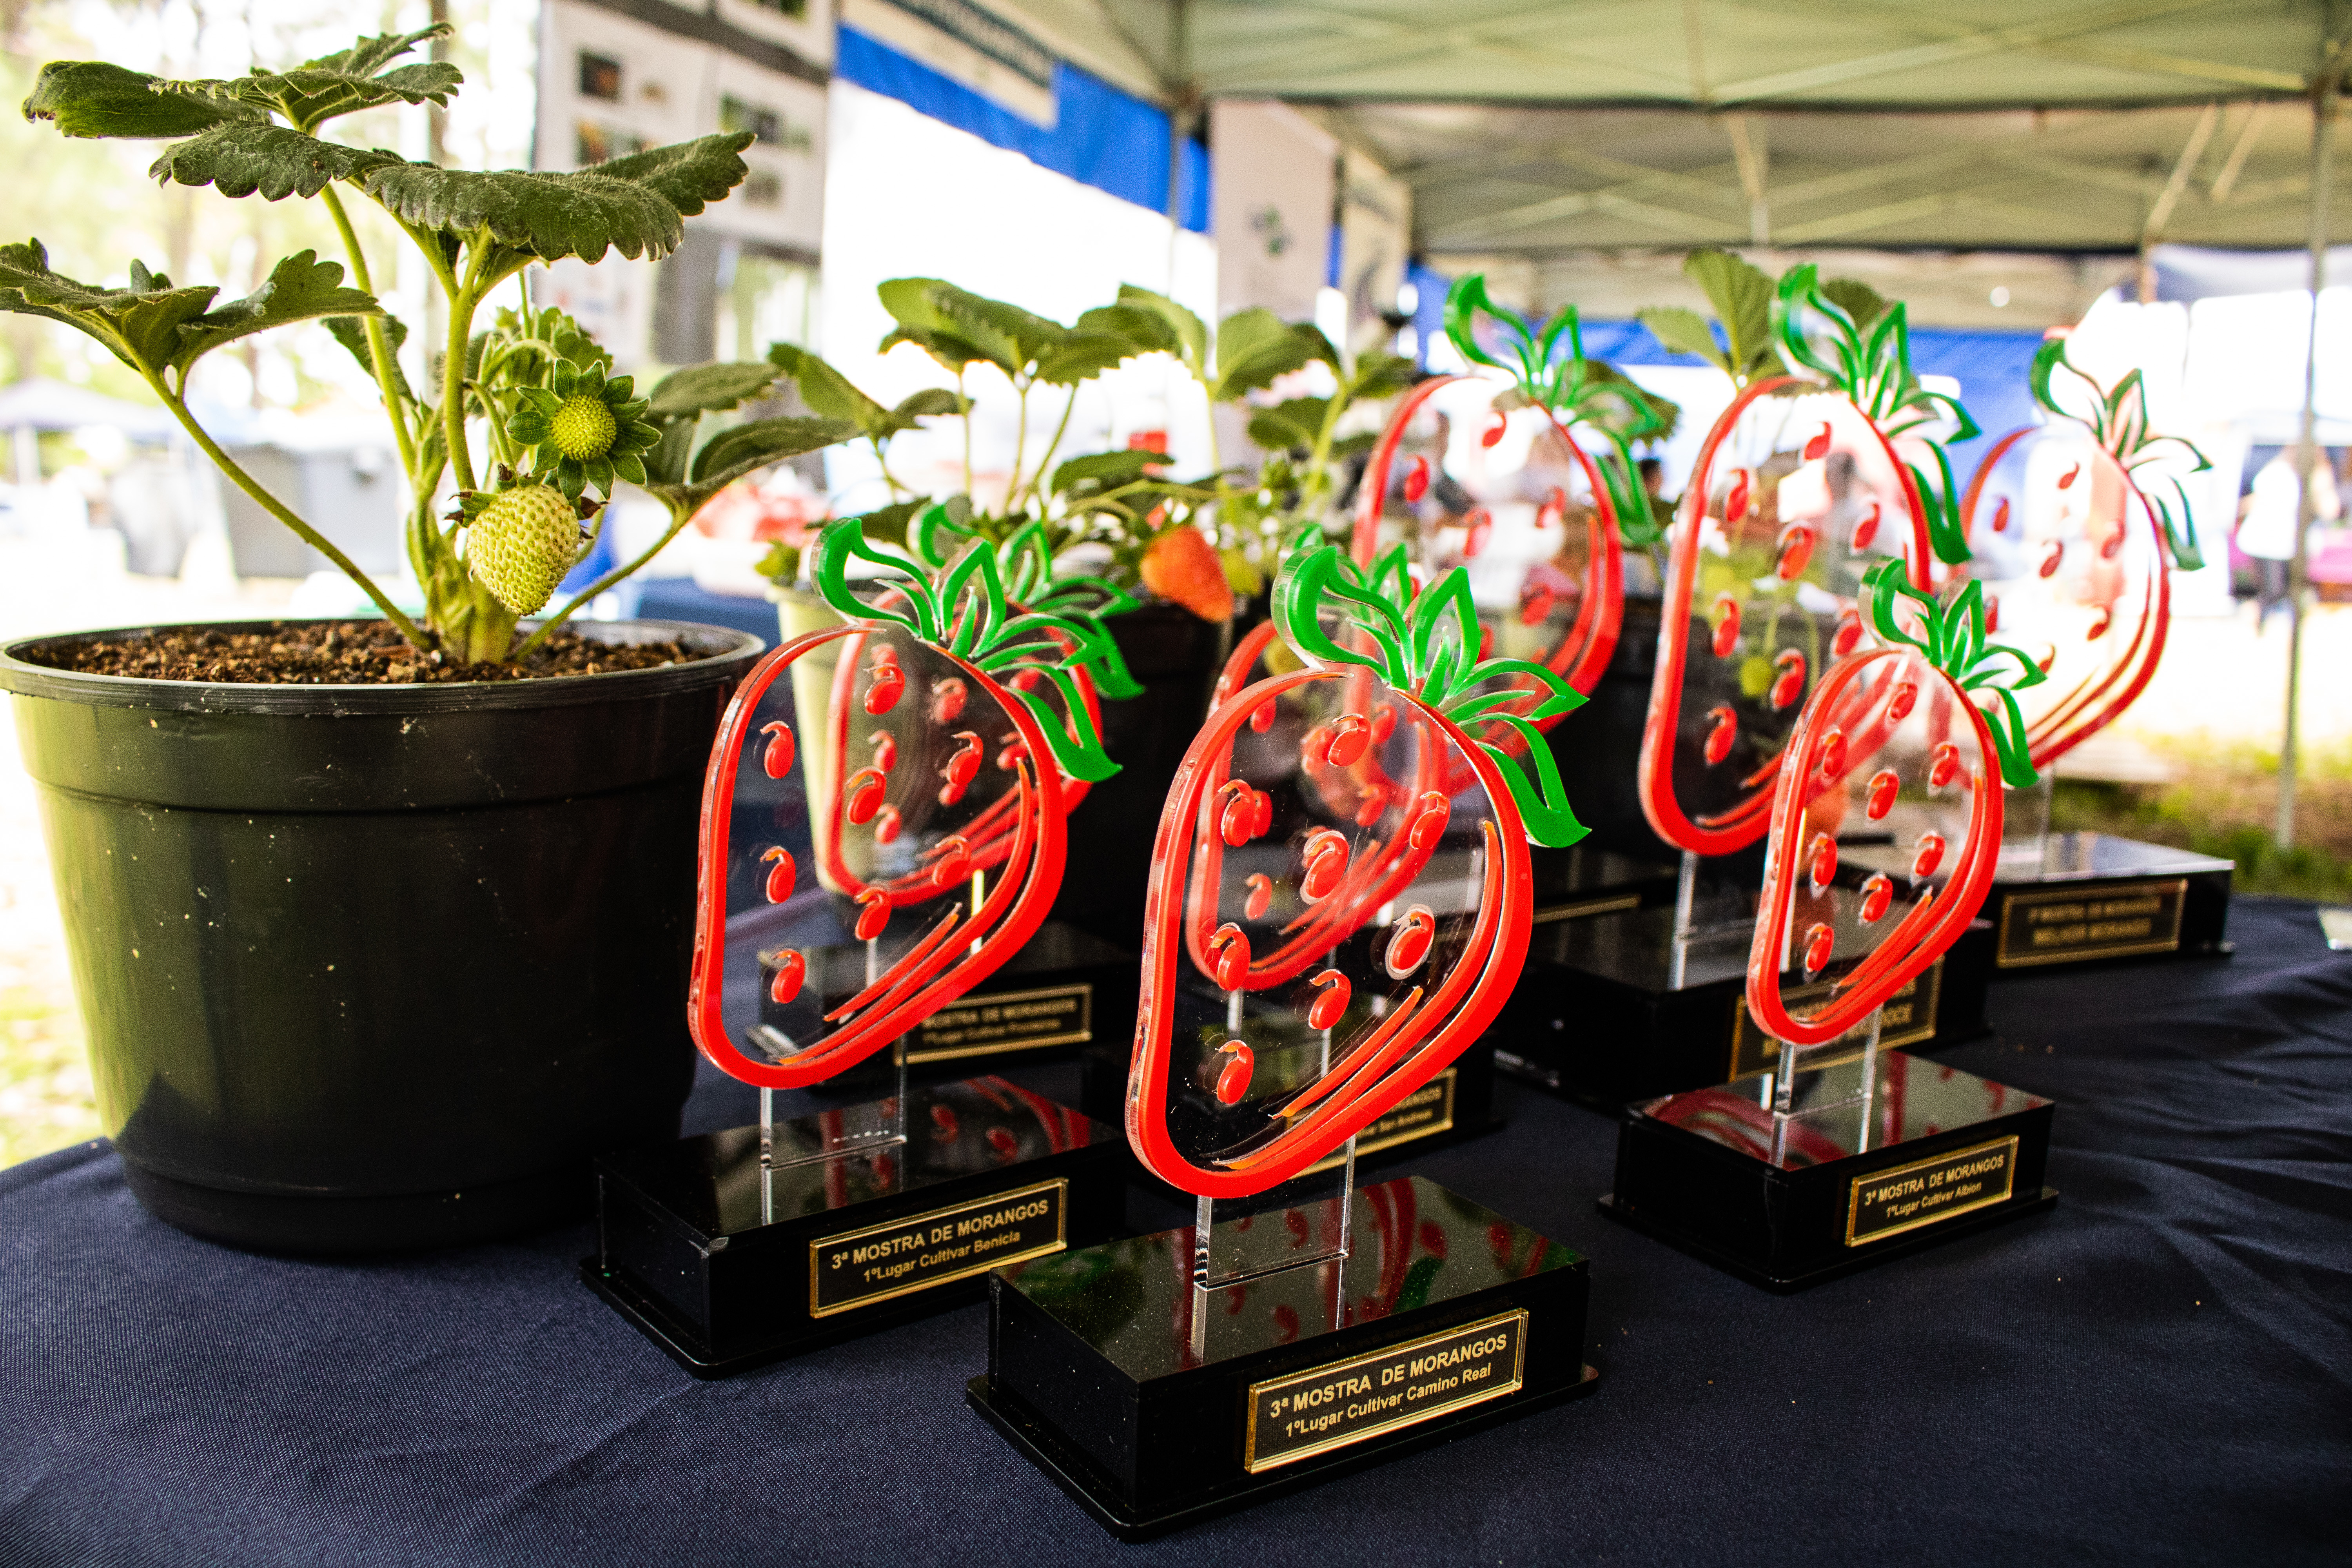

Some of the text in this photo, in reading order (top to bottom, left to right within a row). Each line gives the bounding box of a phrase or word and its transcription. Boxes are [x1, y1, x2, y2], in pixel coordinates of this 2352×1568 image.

[1878, 1177, 1925, 1203] MOSTRA
[1929, 1171, 1944, 1189] DE
[1945, 1154, 2004, 1184] MORANGOS
[1922, 1190, 1955, 1208] Cultivar
[1955, 1182, 1982, 1199] Albion
[831, 1199, 1049, 1270] 3ª MOSTRA DE MORANGOS
[864, 1230, 1020, 1282] 1ºLugar Cultivar Benicia
[1270, 1334, 1506, 1418] 3ª MOSTRA DE MORANGOS
[1286, 1362, 1492, 1437] 1ºLugar Cultivar Camino Real
